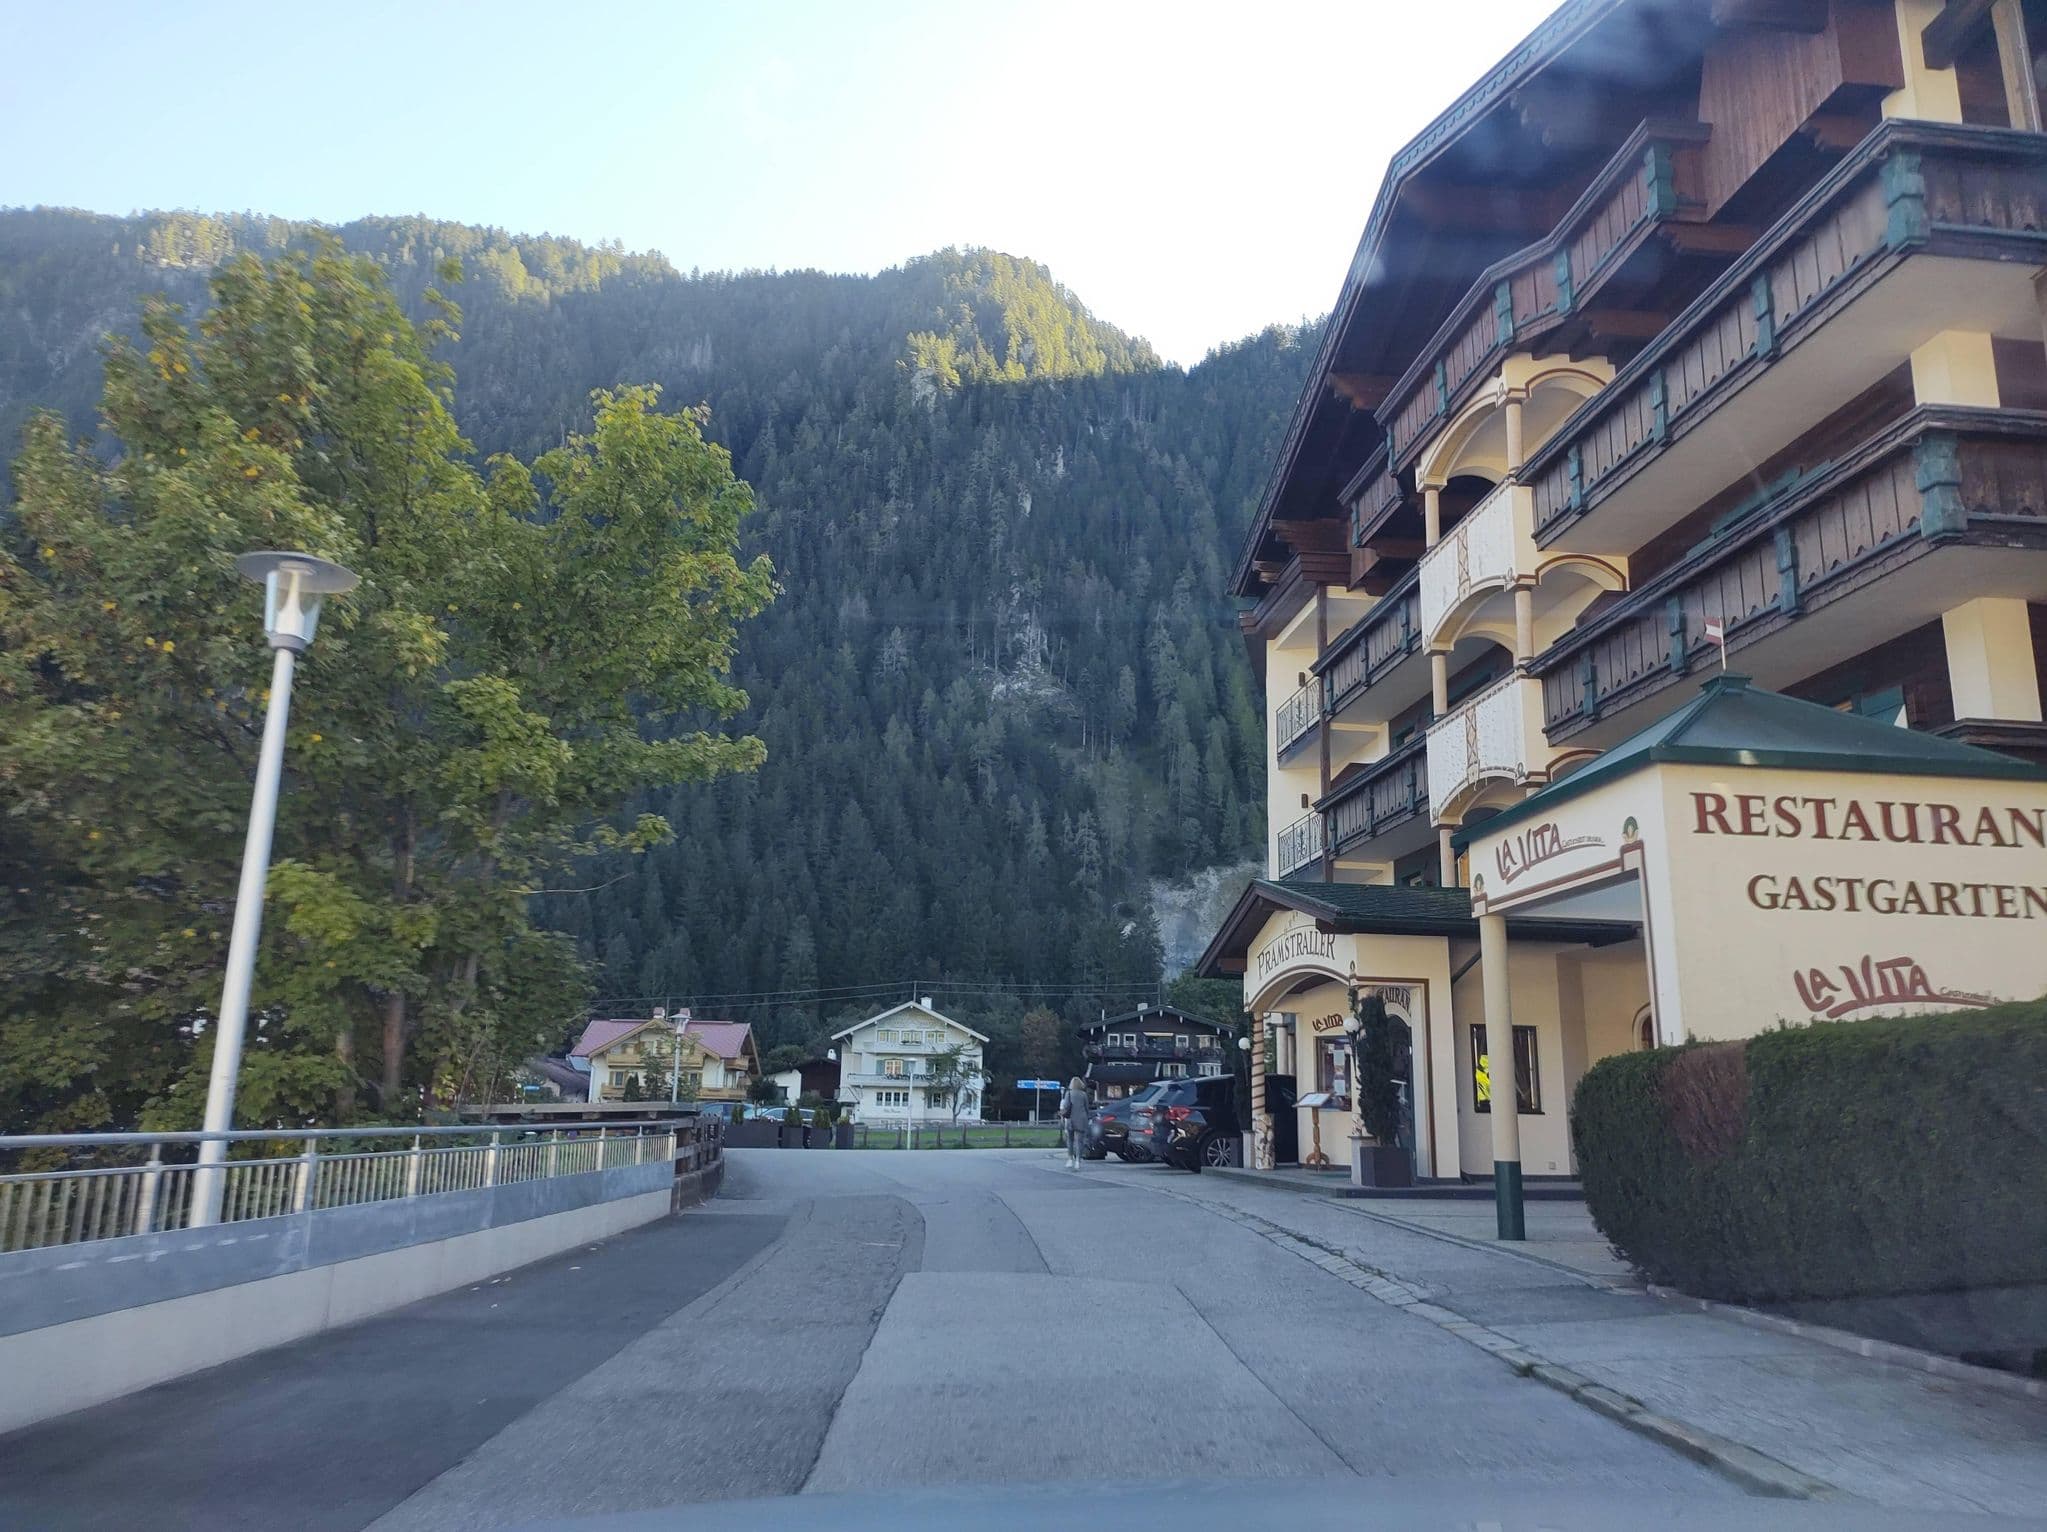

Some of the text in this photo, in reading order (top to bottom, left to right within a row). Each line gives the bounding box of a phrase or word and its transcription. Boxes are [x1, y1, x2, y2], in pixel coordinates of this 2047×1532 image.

[1496, 823, 1563, 880] LA VITA
[1747, 874, 2047, 919] GASTGARTEN
[1257, 931, 1336, 980] PRAMSTRALLER
[1793, 954, 1937, 1012] LA VITA
